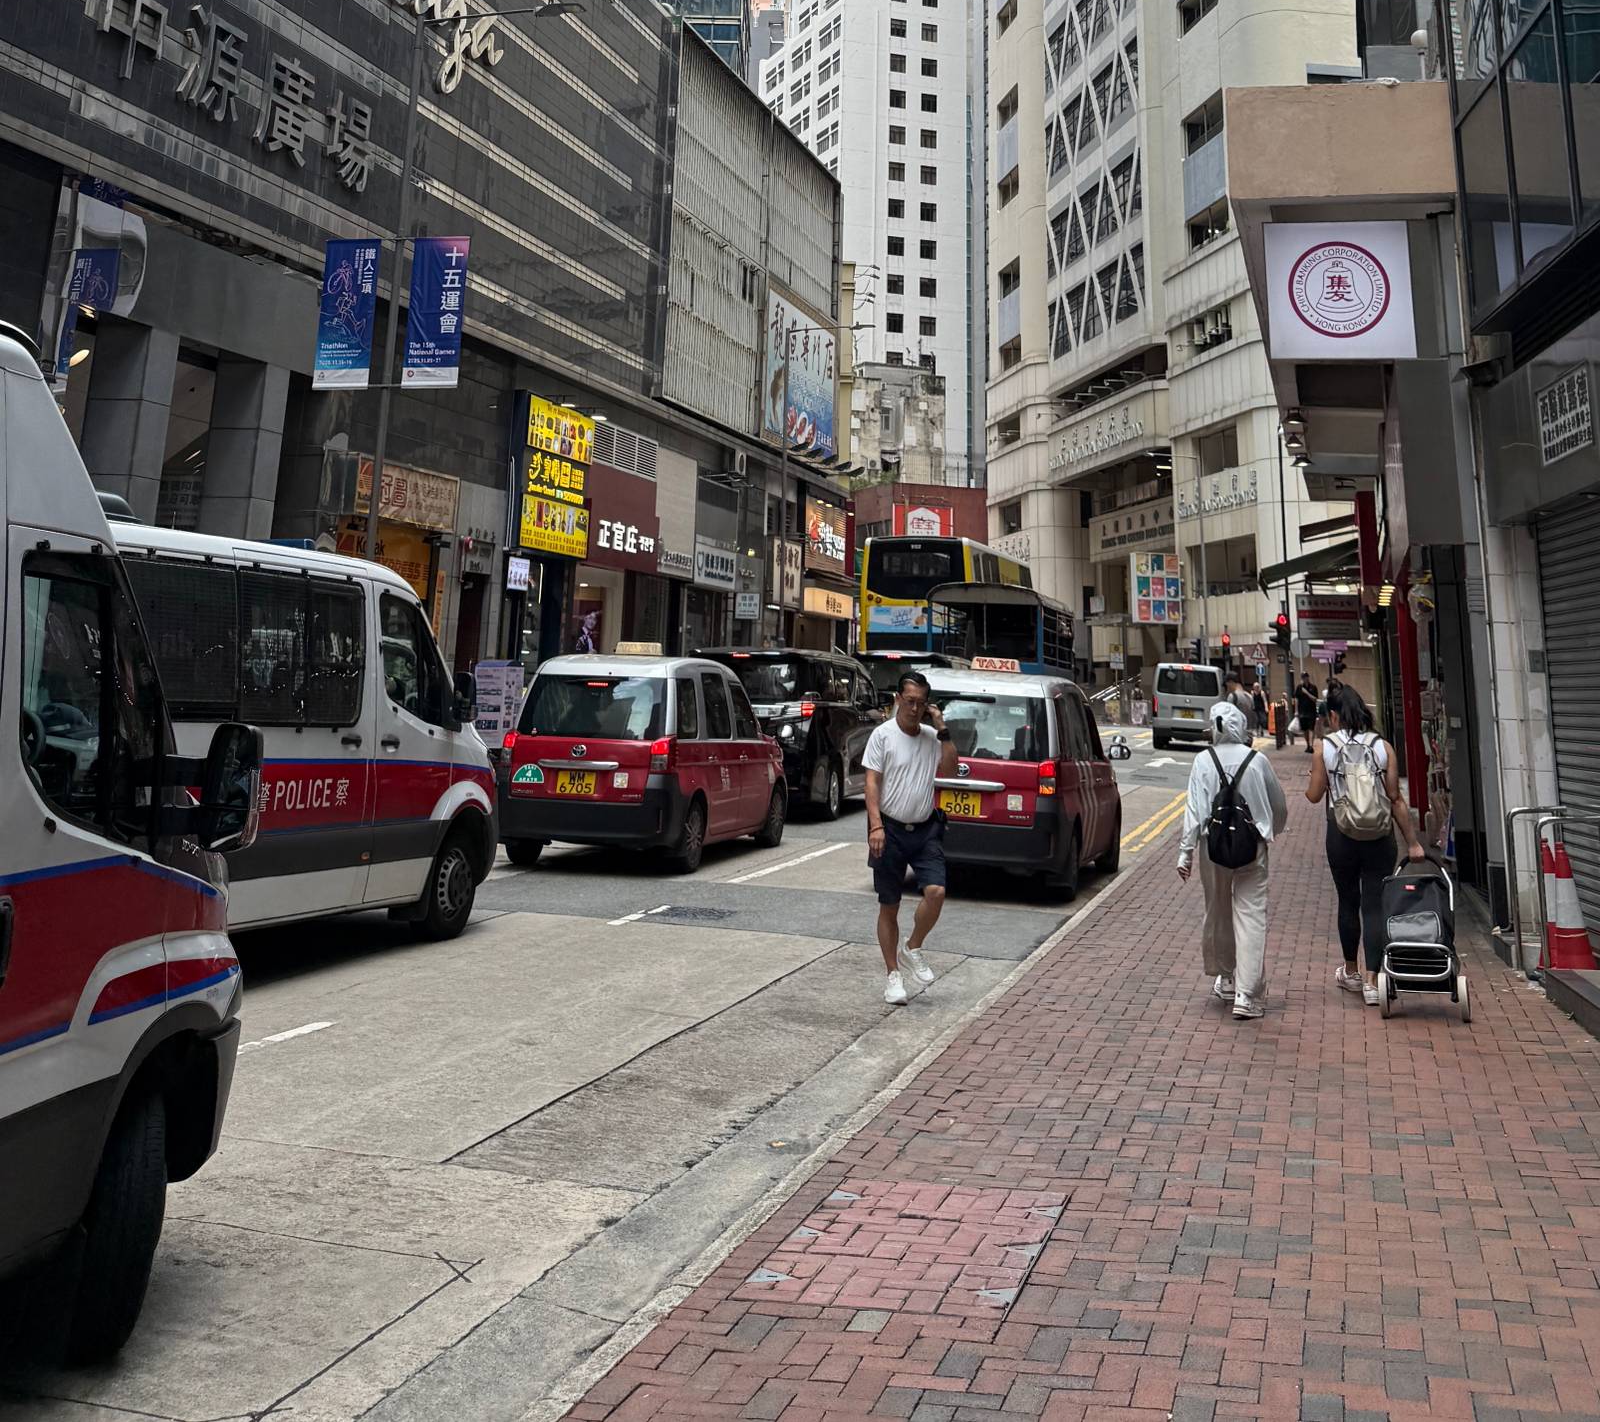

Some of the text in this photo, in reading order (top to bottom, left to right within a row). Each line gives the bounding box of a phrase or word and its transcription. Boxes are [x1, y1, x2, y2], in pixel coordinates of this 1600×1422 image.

[361, 248, 377, 294] 鐵人三項
[1295, 248, 1384, 313] CHIYU BANKING CORPORATION LIMITED
[439, 246, 465, 334] 十五運會
[1324, 275, 1354, 302] 集友
[1315, 317, 1367, 331] HONG KONG
[597, 519, 639, 554] 正官庄
[976, 657, 1016, 670] TAXI
[525, 769, 532, 777] 4
[273, 778, 333, 811] POLICE
[335, 777, 350, 807] 察
[559, 783, 593, 794] 6705
[953, 791, 970, 804] YP
[945, 802, 976, 816] 5081
